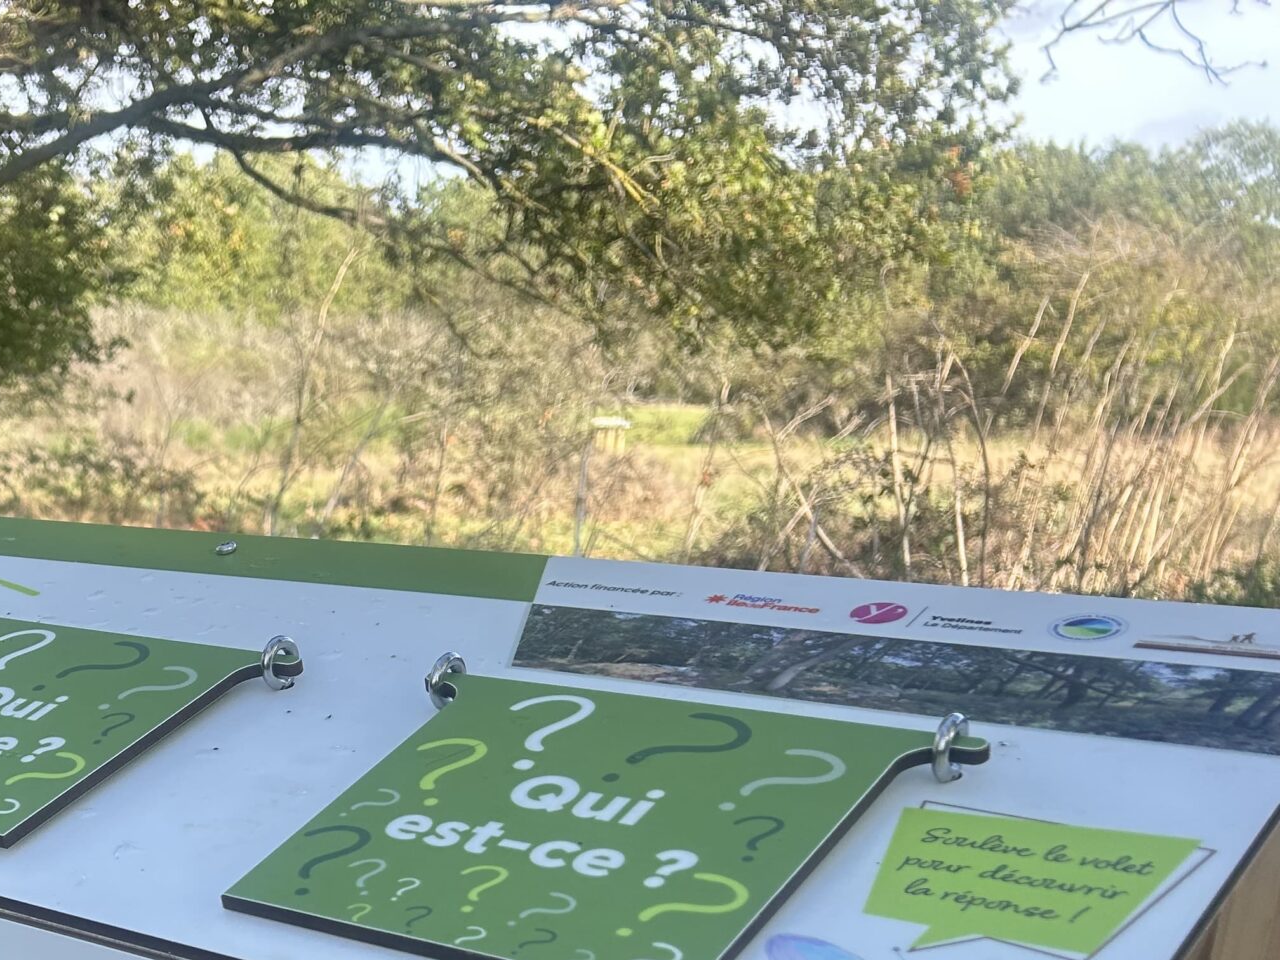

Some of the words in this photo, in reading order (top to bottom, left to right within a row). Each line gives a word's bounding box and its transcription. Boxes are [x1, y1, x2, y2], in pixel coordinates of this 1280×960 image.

[546, 580, 589, 590] Action
[589, 584, 649, 596] financée
[732, 593, 782, 604] Région
[931, 615, 993, 626] Yvelines
[941, 622, 1023, 634] Département
[20, 737, 66, 763] ?
[510, 775, 665, 826] Qui
[384, 814, 625, 877] est-ce
[643, 849, 699, 888] ?
[920, 827, 1037, 857] Soulève
[1043, 845, 1072, 864] le
[1080, 855, 1155, 876] volet
[896, 855, 972, 872] pour
[979, 864, 1129, 900] découvrir
[903, 878, 933, 897] la
[939, 889, 1060, 920] réponse
